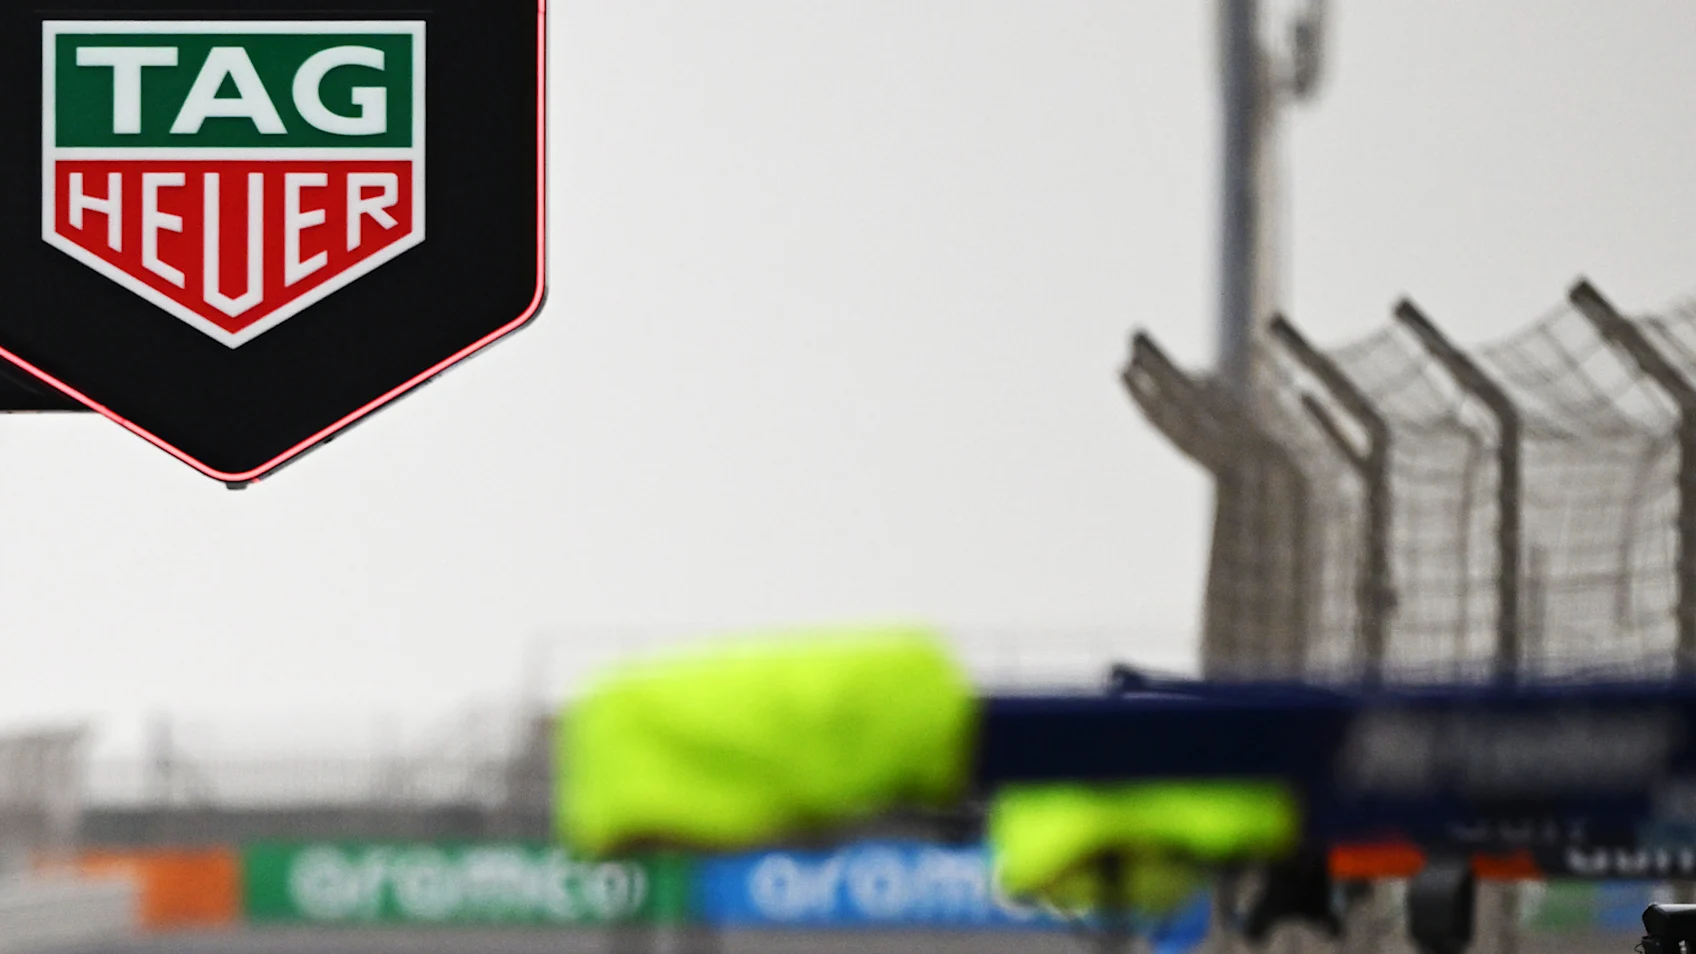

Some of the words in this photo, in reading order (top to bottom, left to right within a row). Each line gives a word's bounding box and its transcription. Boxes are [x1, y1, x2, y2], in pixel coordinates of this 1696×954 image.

[75, 45, 388, 136] TAG
[68, 172, 399, 318] HEUER
[748, 841, 1090, 920] aram
